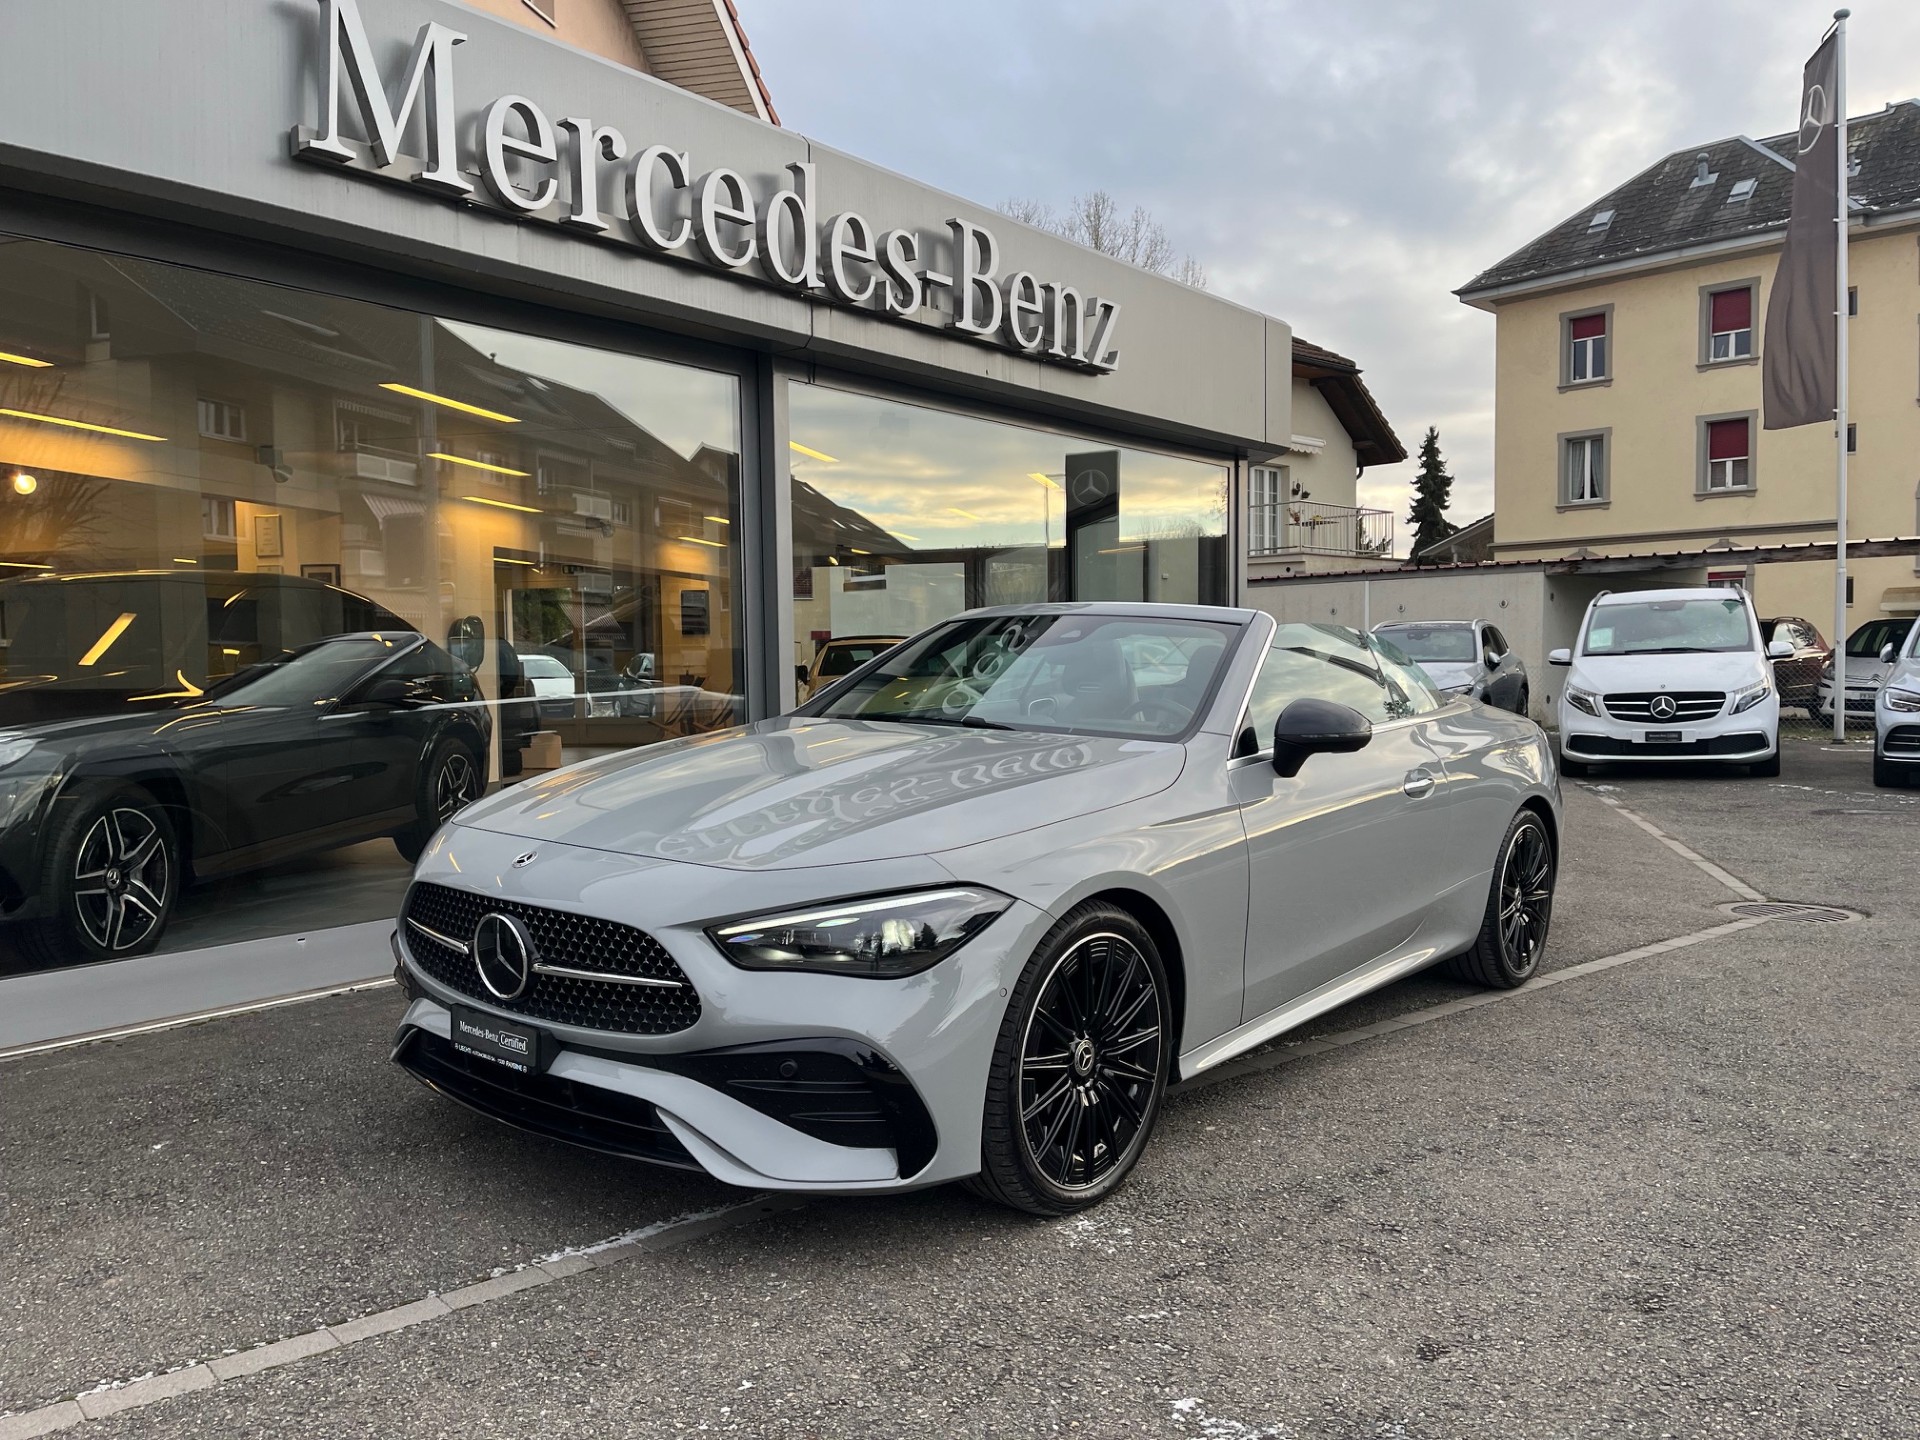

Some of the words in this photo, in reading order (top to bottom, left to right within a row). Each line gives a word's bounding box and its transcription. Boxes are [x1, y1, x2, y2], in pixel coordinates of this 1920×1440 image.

[291, 0, 1122, 374] Mercedes-Benz
[459, 1020, 499, 1042] Mercedes-Benz
[500, 1034, 526, 1051] Certified
